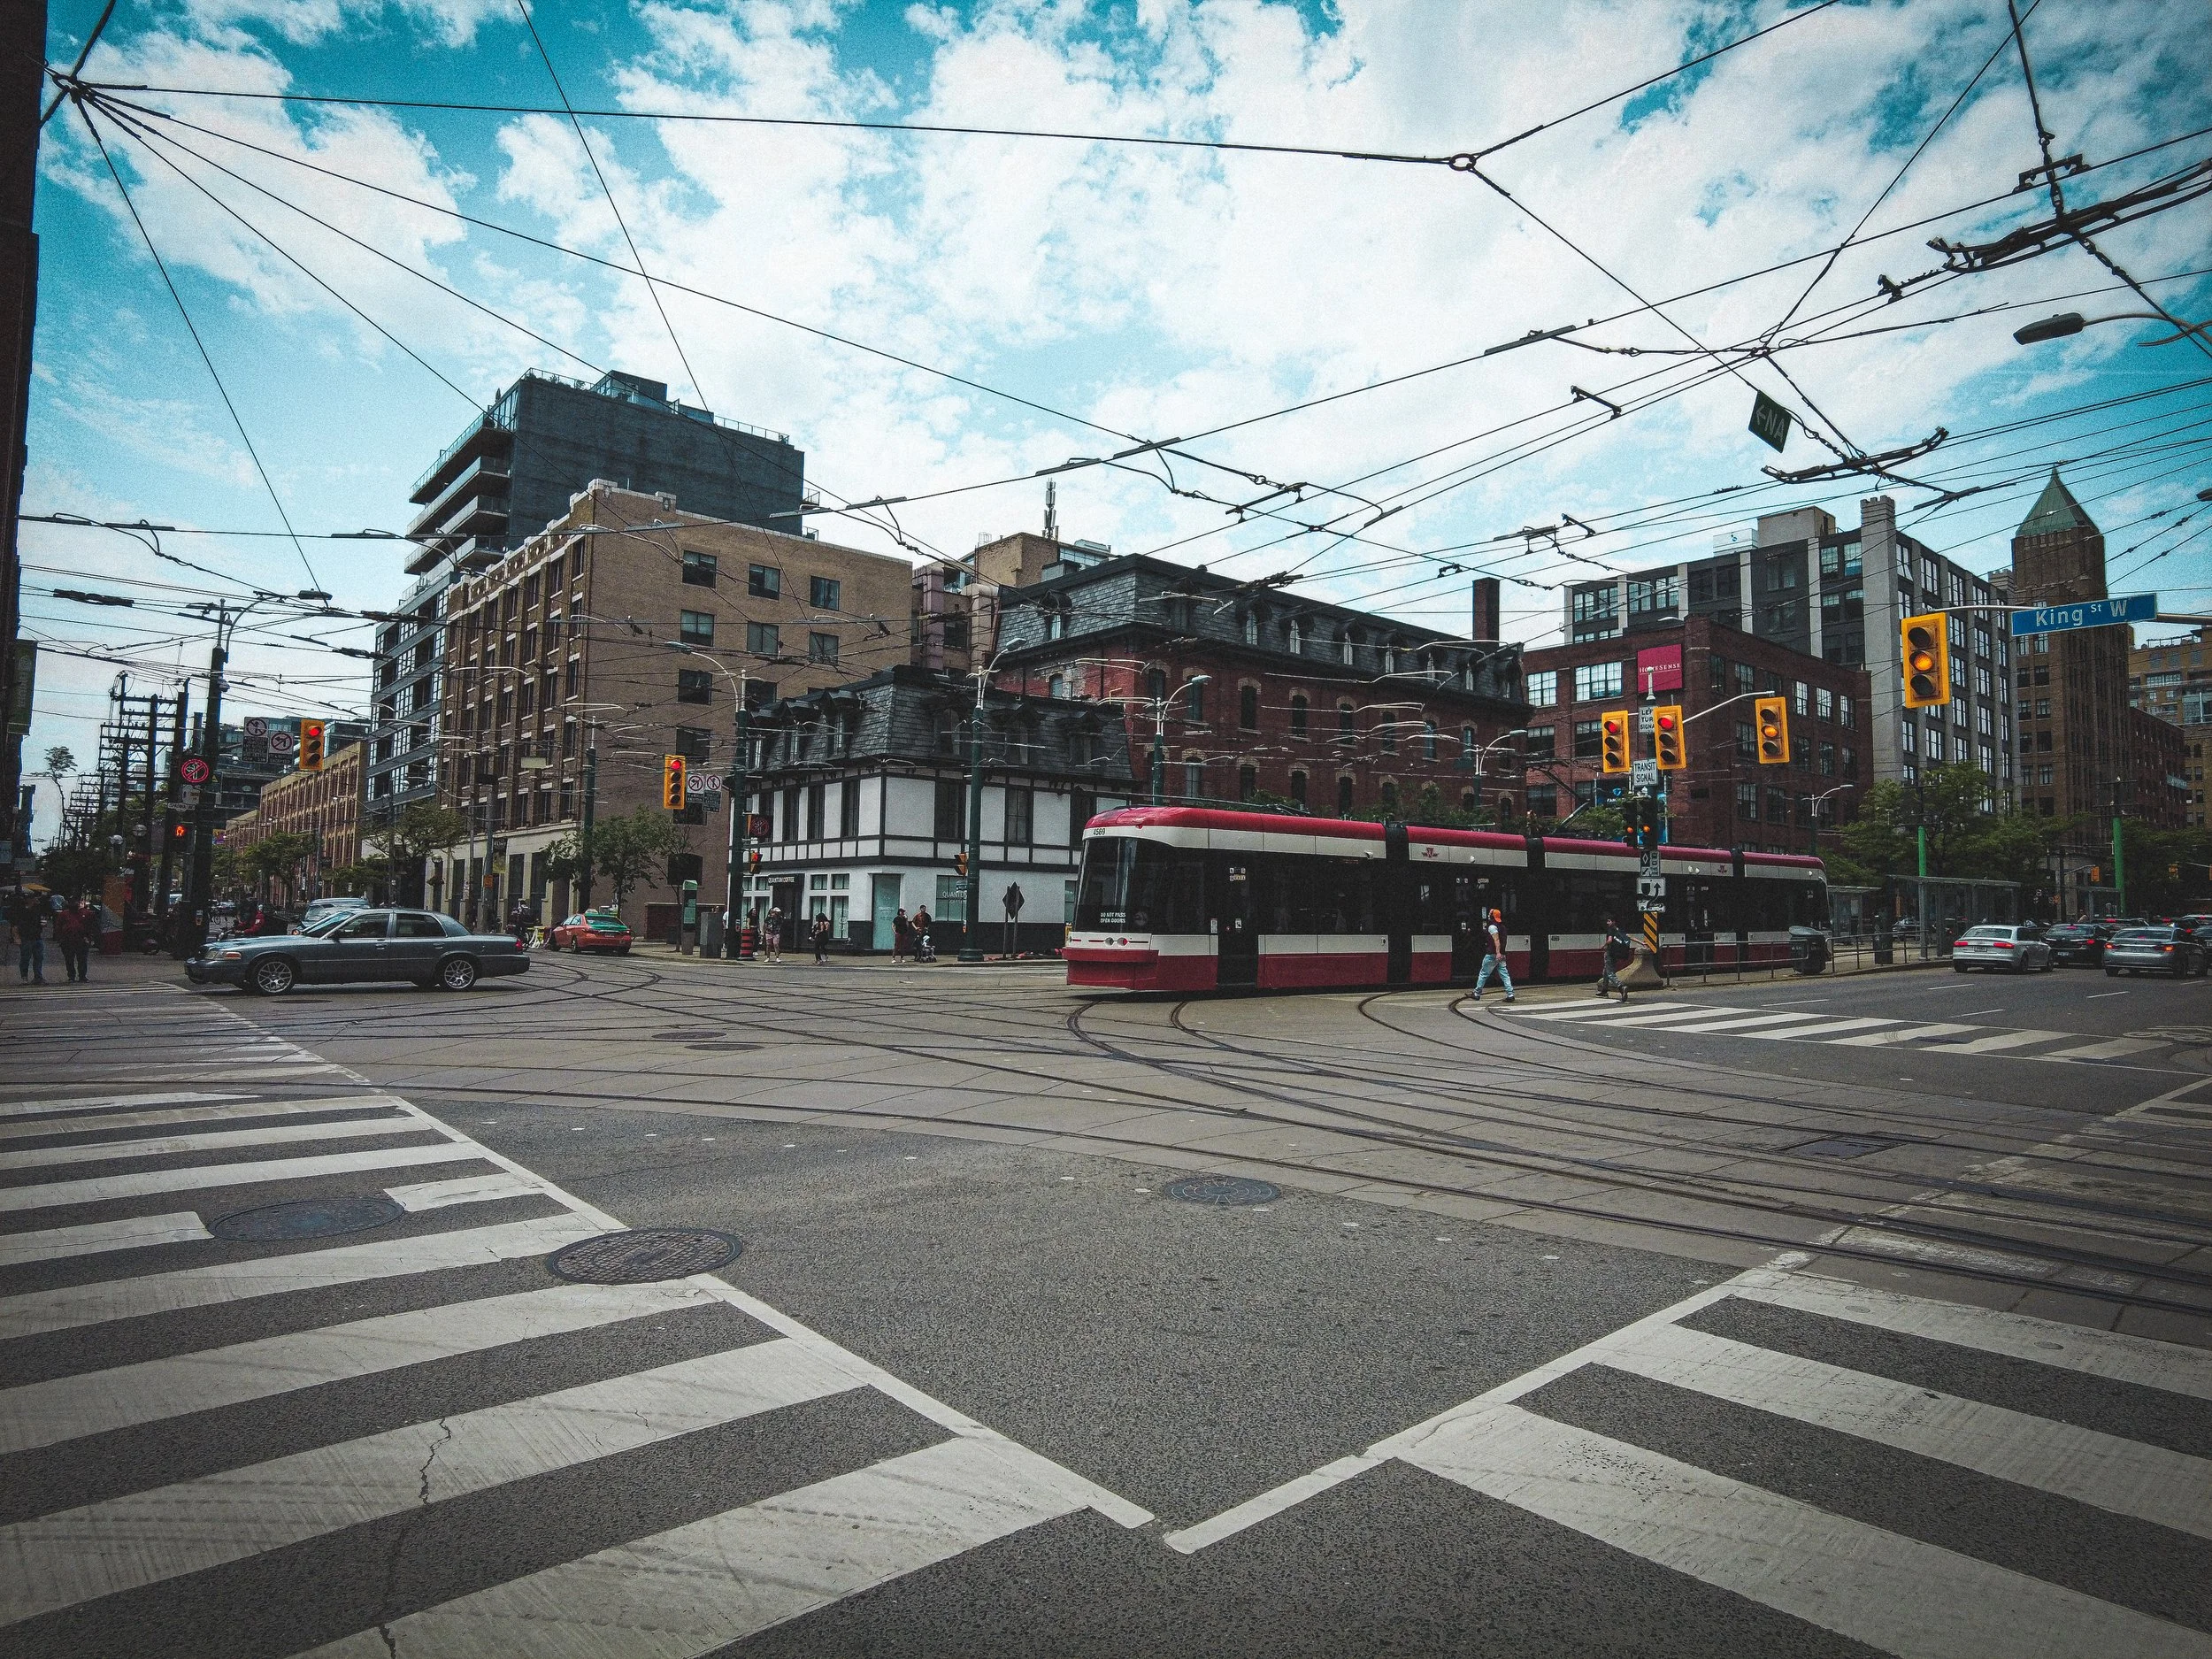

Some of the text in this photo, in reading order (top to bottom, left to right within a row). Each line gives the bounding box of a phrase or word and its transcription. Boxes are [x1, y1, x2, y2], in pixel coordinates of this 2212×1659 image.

[2036, 600, 2128, 626] King St W
[1634, 761, 1655, 772] TRANSIT
[1636, 772, 1655, 783] SIGNAL
